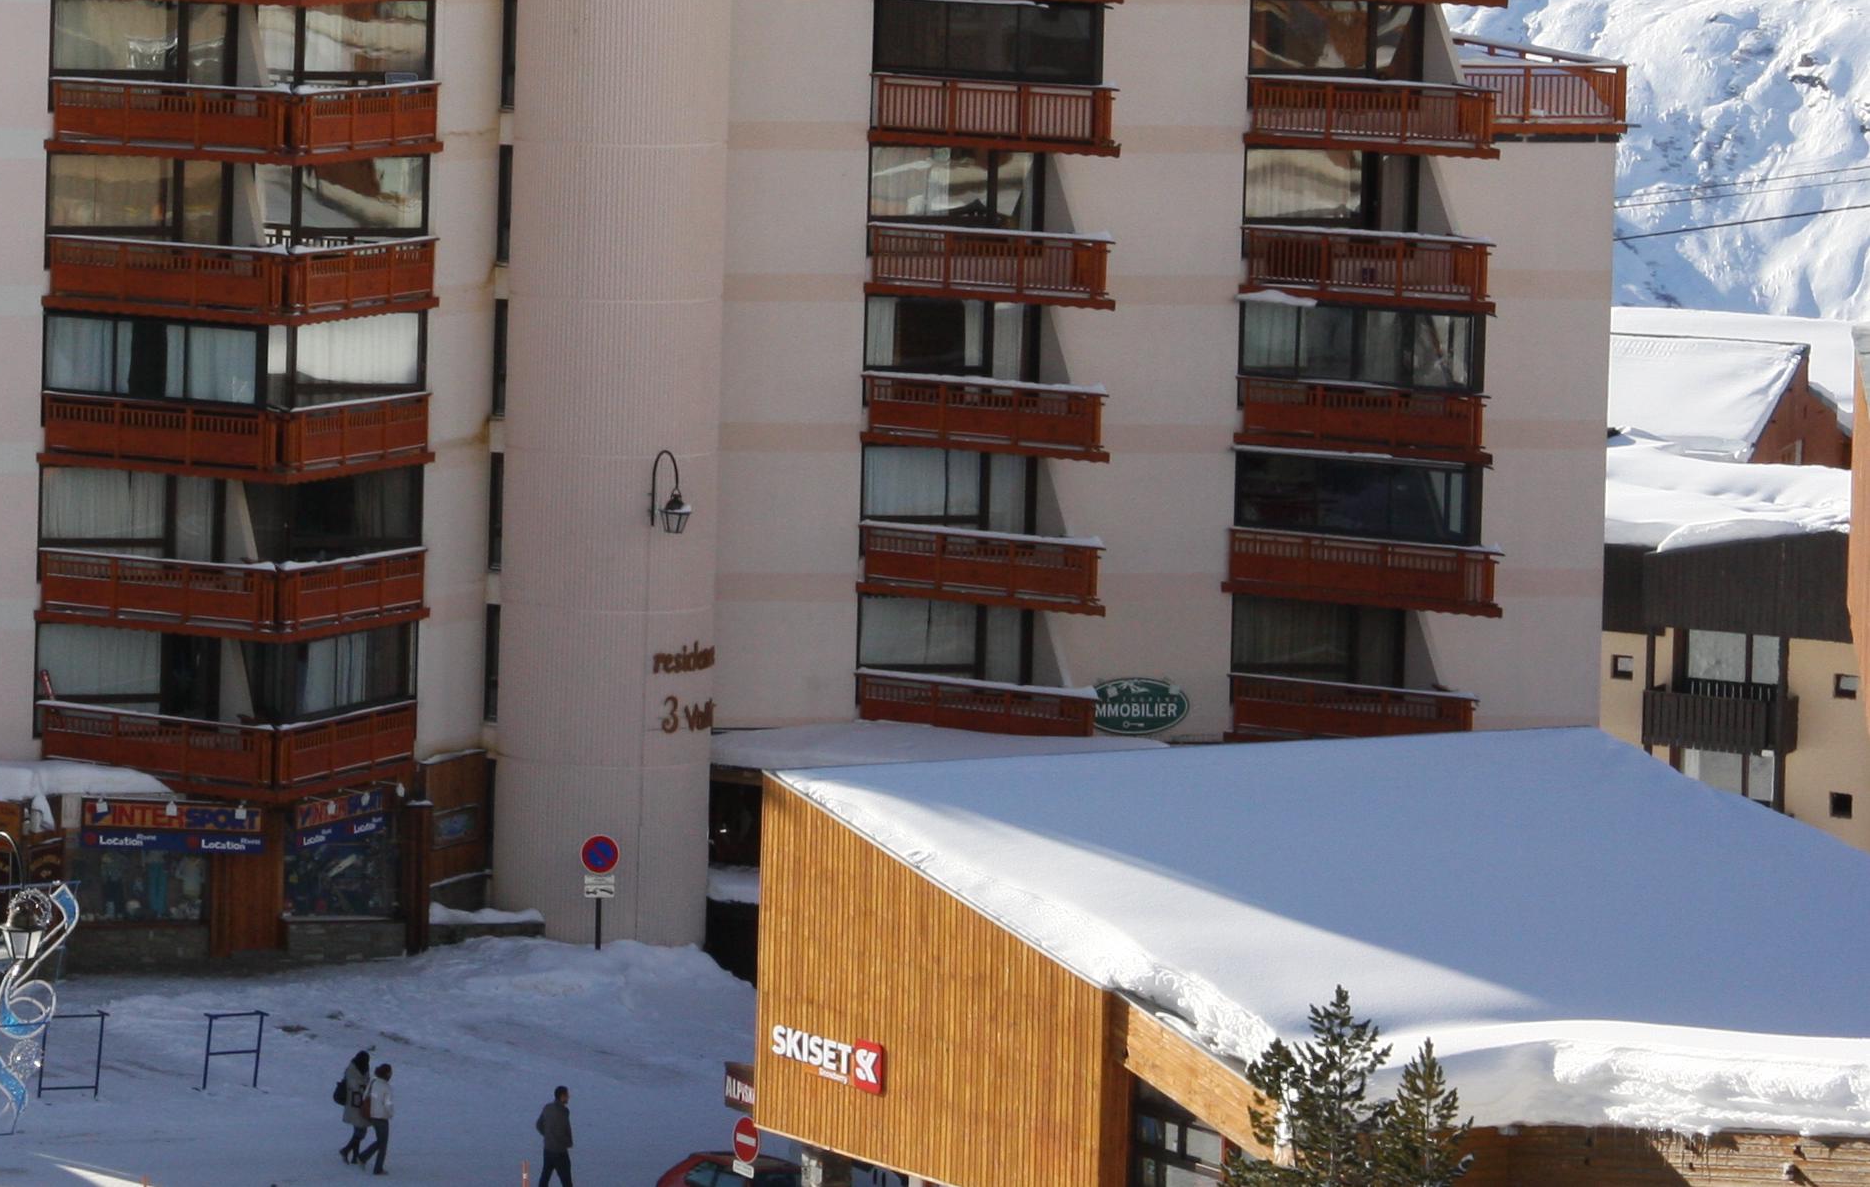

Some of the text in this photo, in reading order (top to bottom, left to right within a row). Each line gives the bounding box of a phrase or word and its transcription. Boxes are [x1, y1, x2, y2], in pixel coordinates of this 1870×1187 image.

[661, 695, 679, 734] 3
[1095, 703, 1177, 717] MMOBILIER
[112, 804, 260, 830] INTERSPORT
[99, 835, 144, 846] Location
[201, 839, 246, 850] Location
[771, 1024, 852, 1075] SKISET
